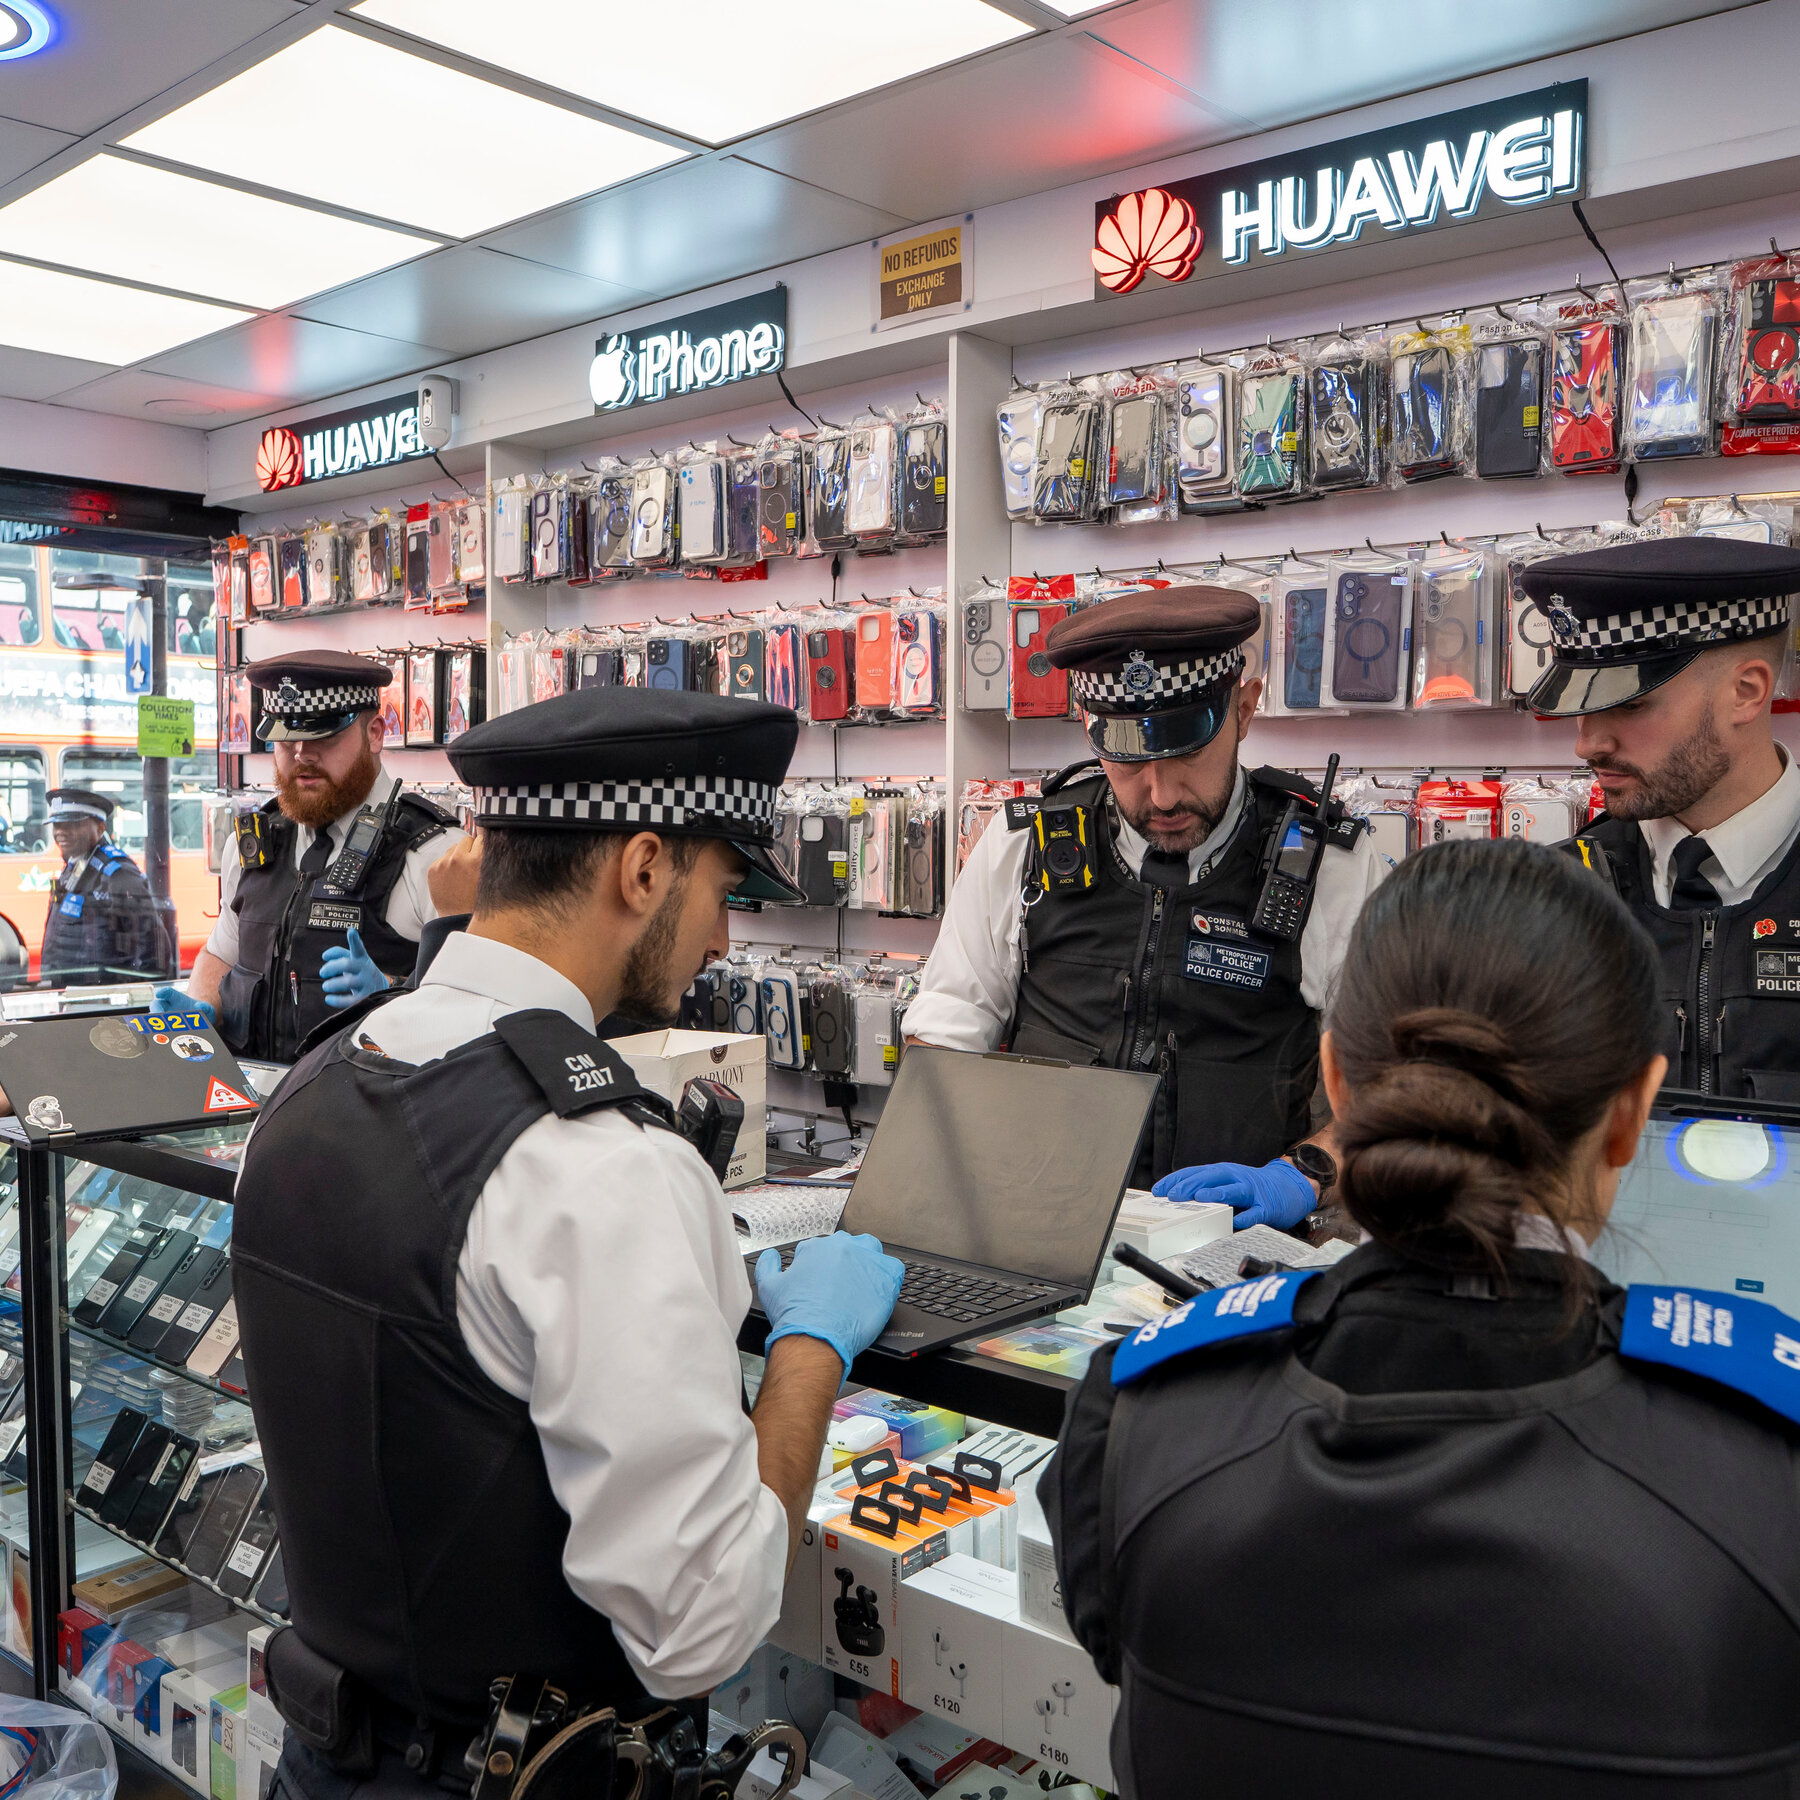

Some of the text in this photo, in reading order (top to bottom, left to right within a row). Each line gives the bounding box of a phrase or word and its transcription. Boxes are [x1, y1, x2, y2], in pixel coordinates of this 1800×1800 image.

[1221, 109, 1582, 265] HUAWEI
[884, 236, 957, 274] NO REFUNDS
[896, 271, 945, 297] EXCHANGE
[908, 290, 933, 309] ONLY
[637, 322, 784, 402] iPhone
[1734, 427, 1771, 438] COMPLETE
[1031, 590, 1052, 598] NEW
[140, 703, 193, 713] COLLECTION
[155, 712, 179, 721] TIMES
[849, 851, 860, 892] Quality
[325, 905, 359, 914] METROPOLITAN
[308, 918, 360, 930] POLICE OFFICER
[1214, 924, 1249, 938] SONMEZ
[1216, 948, 1262, 963] METROPOLITAN
[1221, 955, 1255, 971] POLICE
[1186, 964, 1263, 988] POLICE OFFICER
[1757, 979, 1800, 992] POLICE
[129, 1013, 201, 1033] 1927
[564, 1053, 597, 1073] CN
[567, 1066, 616, 1093] 2207
[696, 1064, 746, 1087] RMONY
[729, 1165, 744, 1180] PCS.
[849, 1659, 870, 1677] £55
[193, 1703, 207, 1716] NOKIA
[934, 1694, 960, 1715] £120
[224, 1717, 234, 1754] £20
[1040, 1743, 1069, 1766] £180
